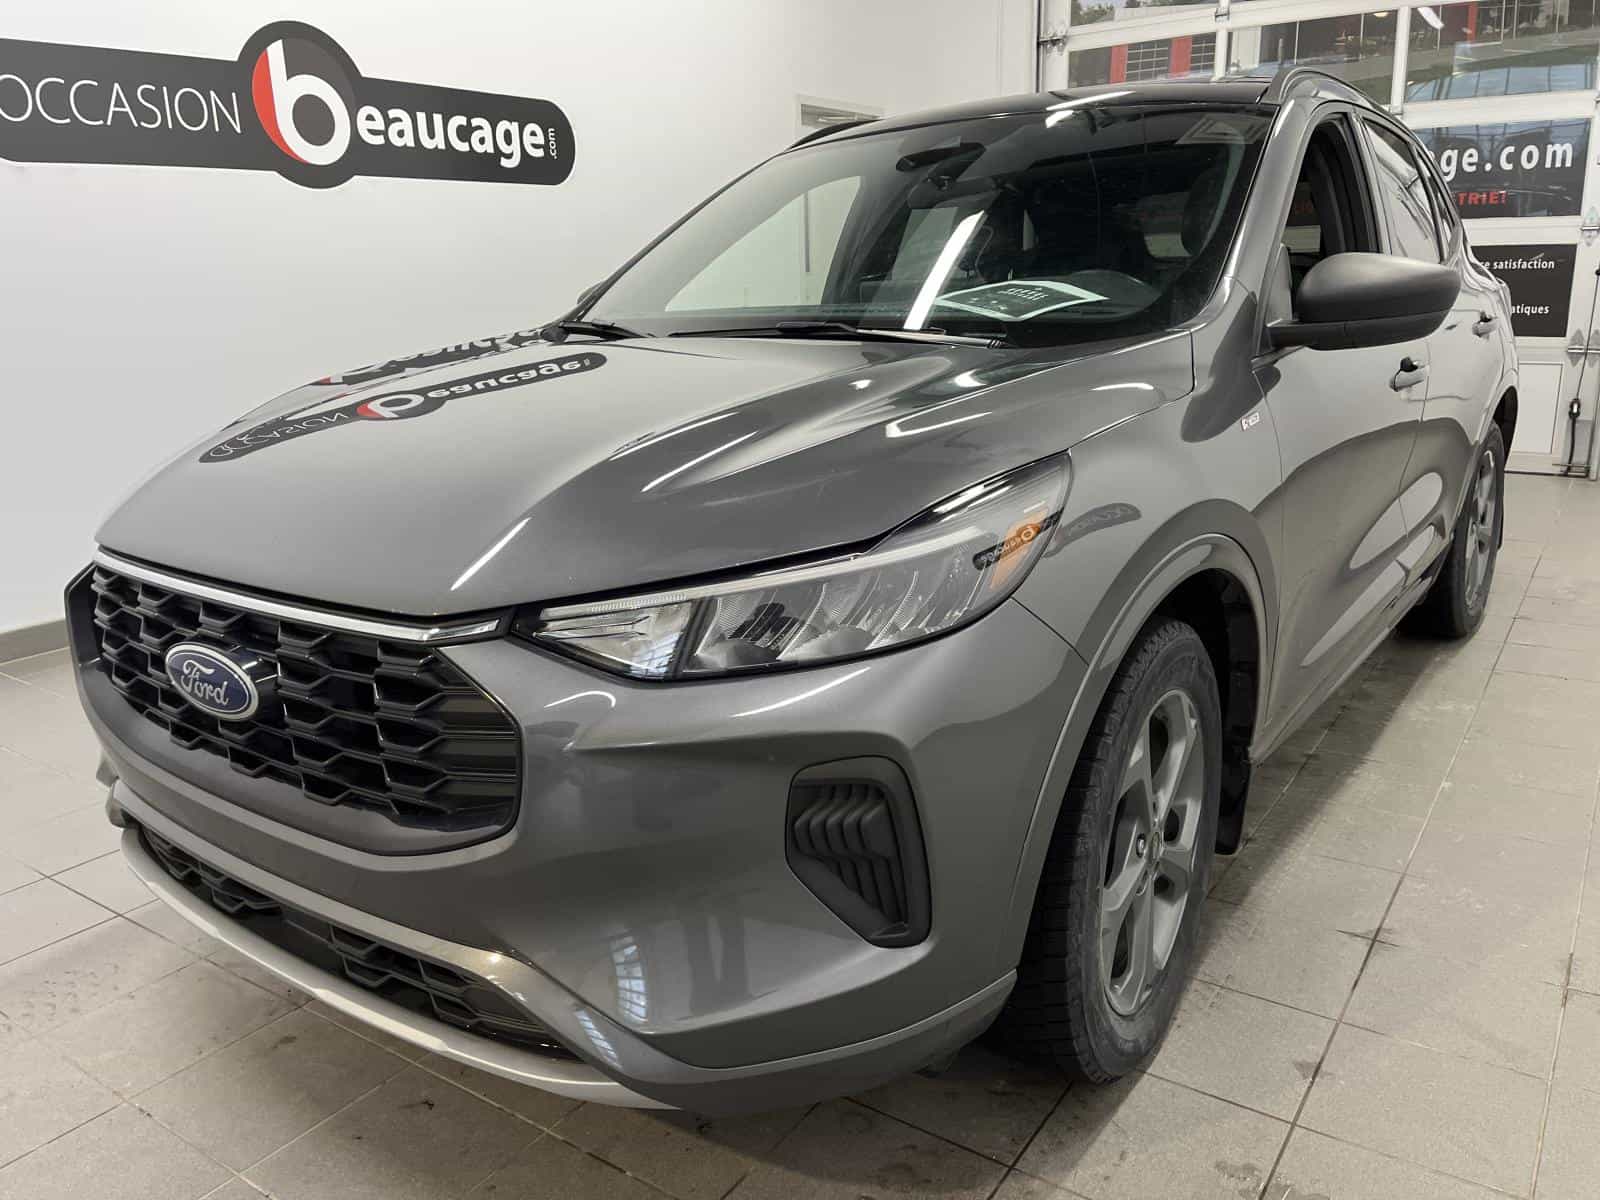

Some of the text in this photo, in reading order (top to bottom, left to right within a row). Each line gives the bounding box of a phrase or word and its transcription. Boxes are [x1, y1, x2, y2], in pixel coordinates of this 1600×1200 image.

[0, 73, 242, 135] OCCASION
[1429, 142, 1573, 182] ge.com
[1493, 258, 1555, 270] satisfaction
[180, 659, 230, 706] Ford
